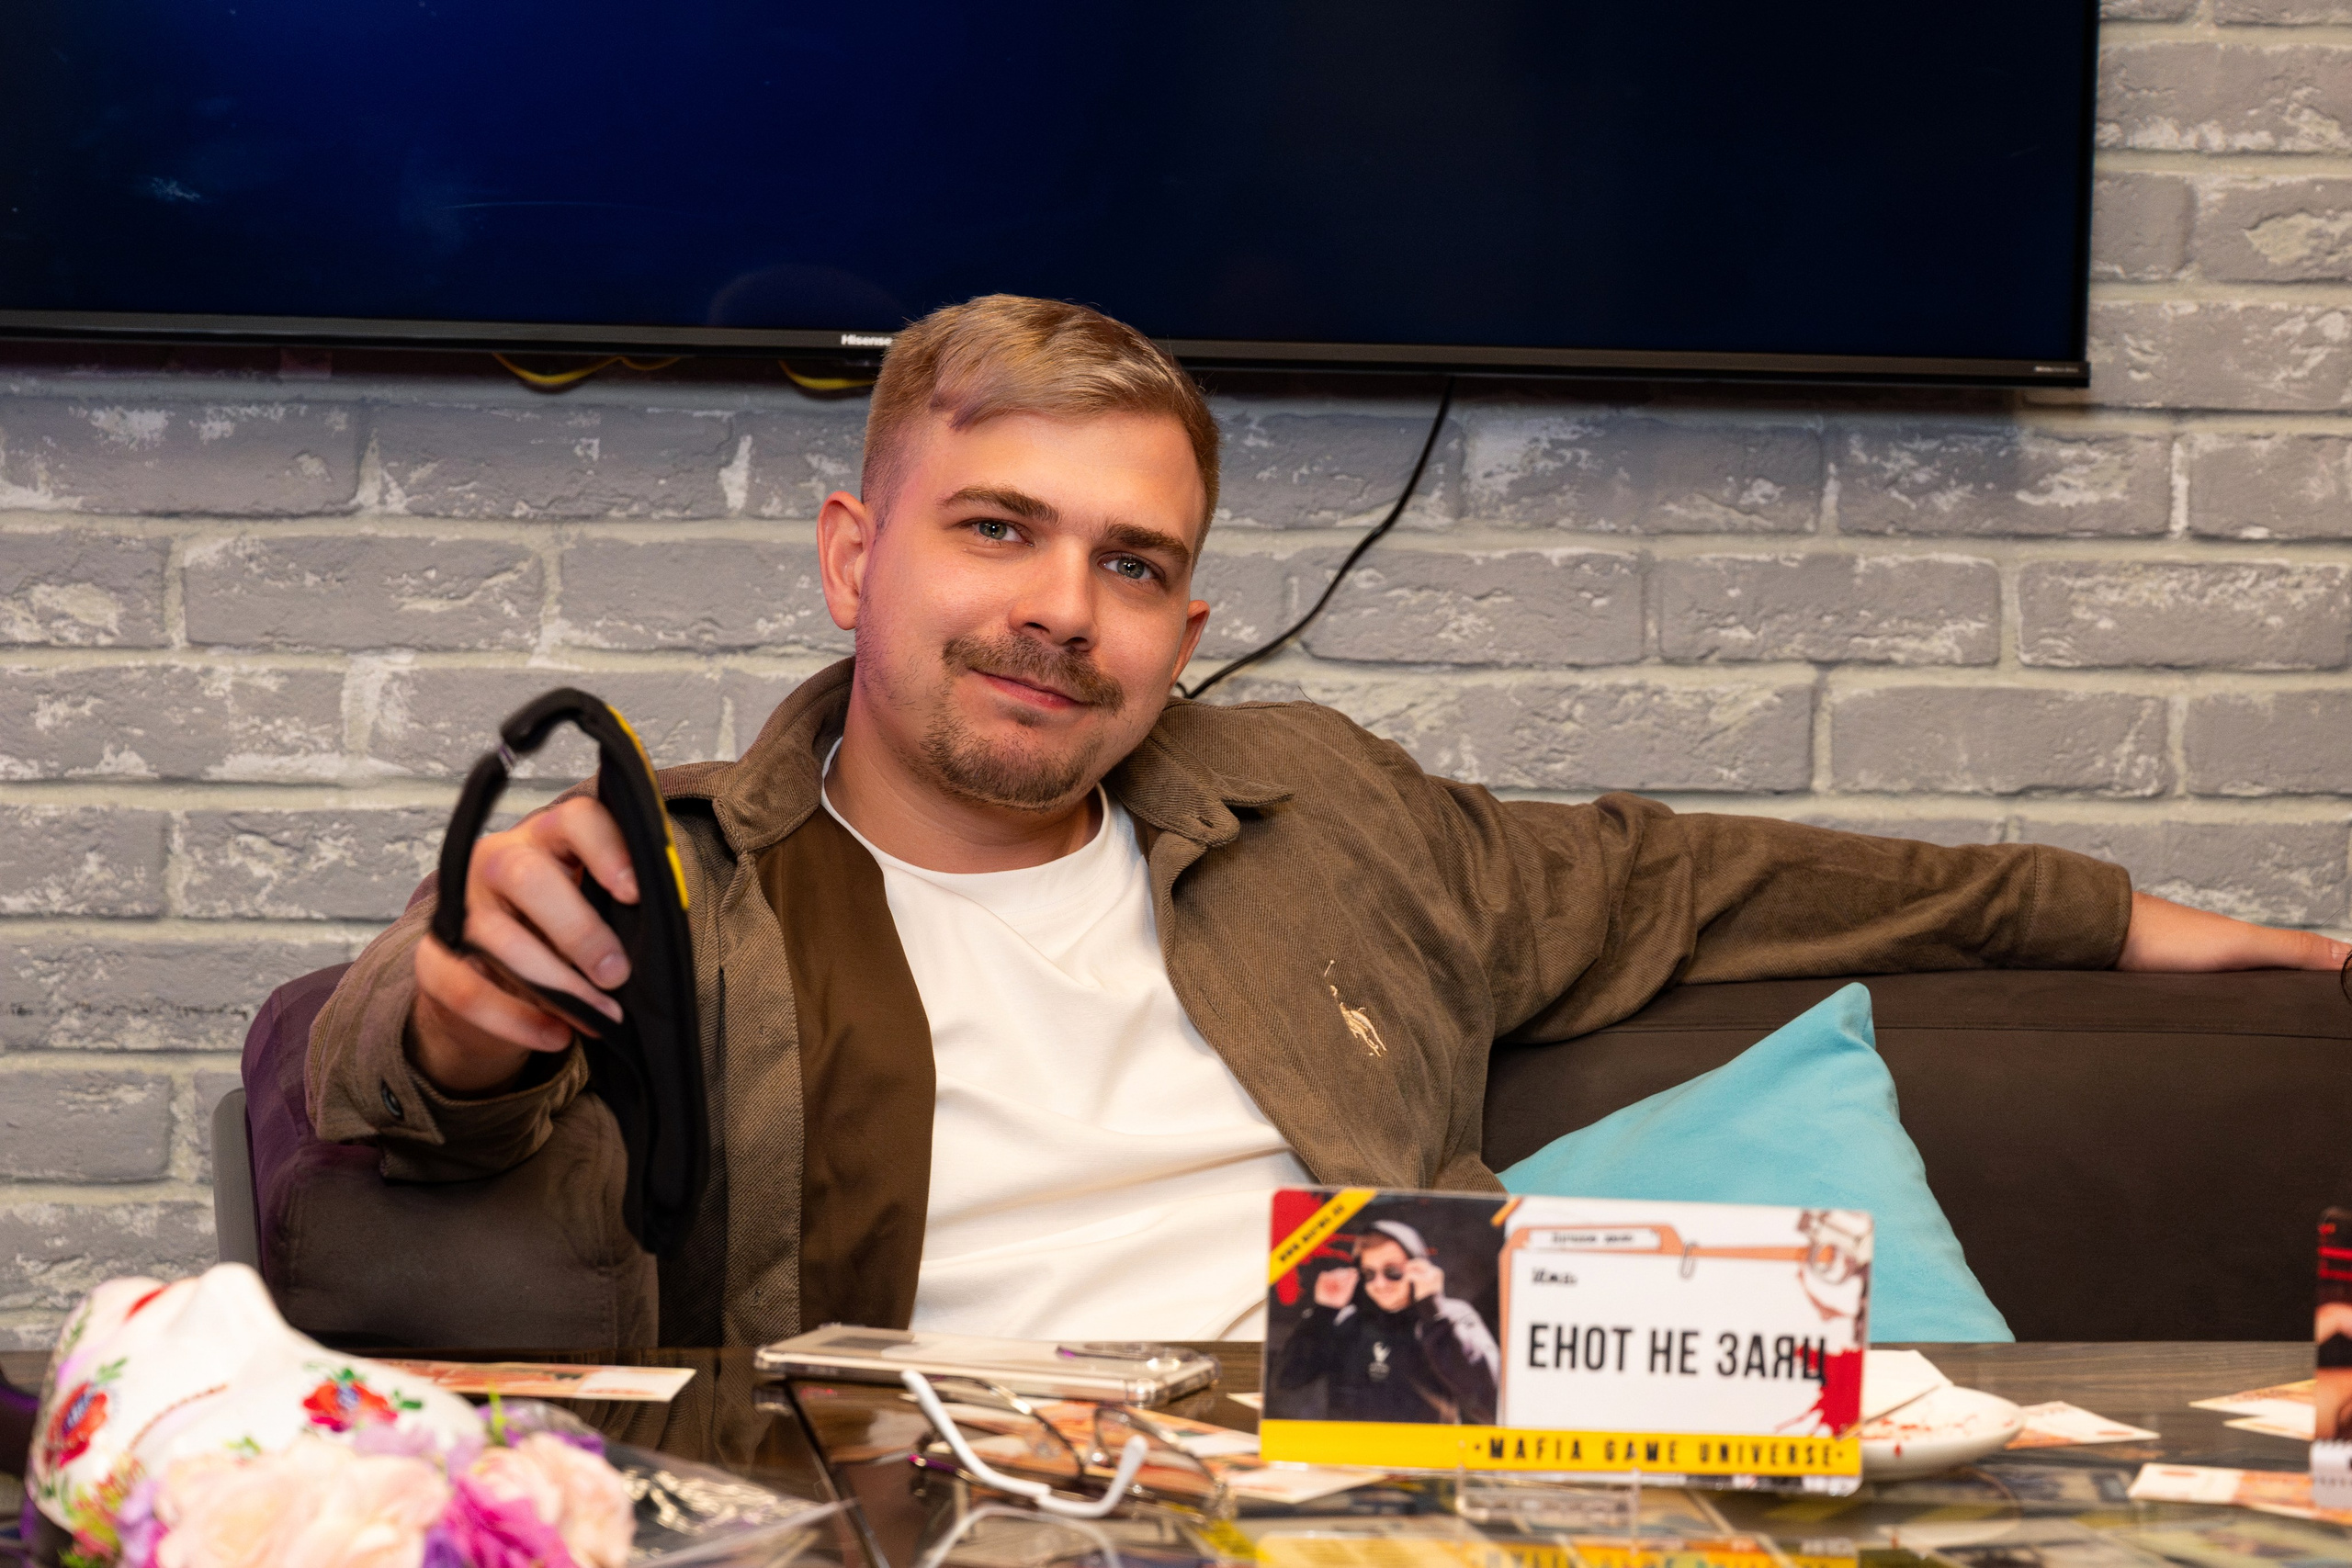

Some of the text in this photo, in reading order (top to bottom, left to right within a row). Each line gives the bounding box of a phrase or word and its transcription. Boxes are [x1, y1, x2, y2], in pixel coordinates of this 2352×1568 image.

[1529, 1324, 1826, 1387] ЕНОТ НЕ ЗАЯЦ
